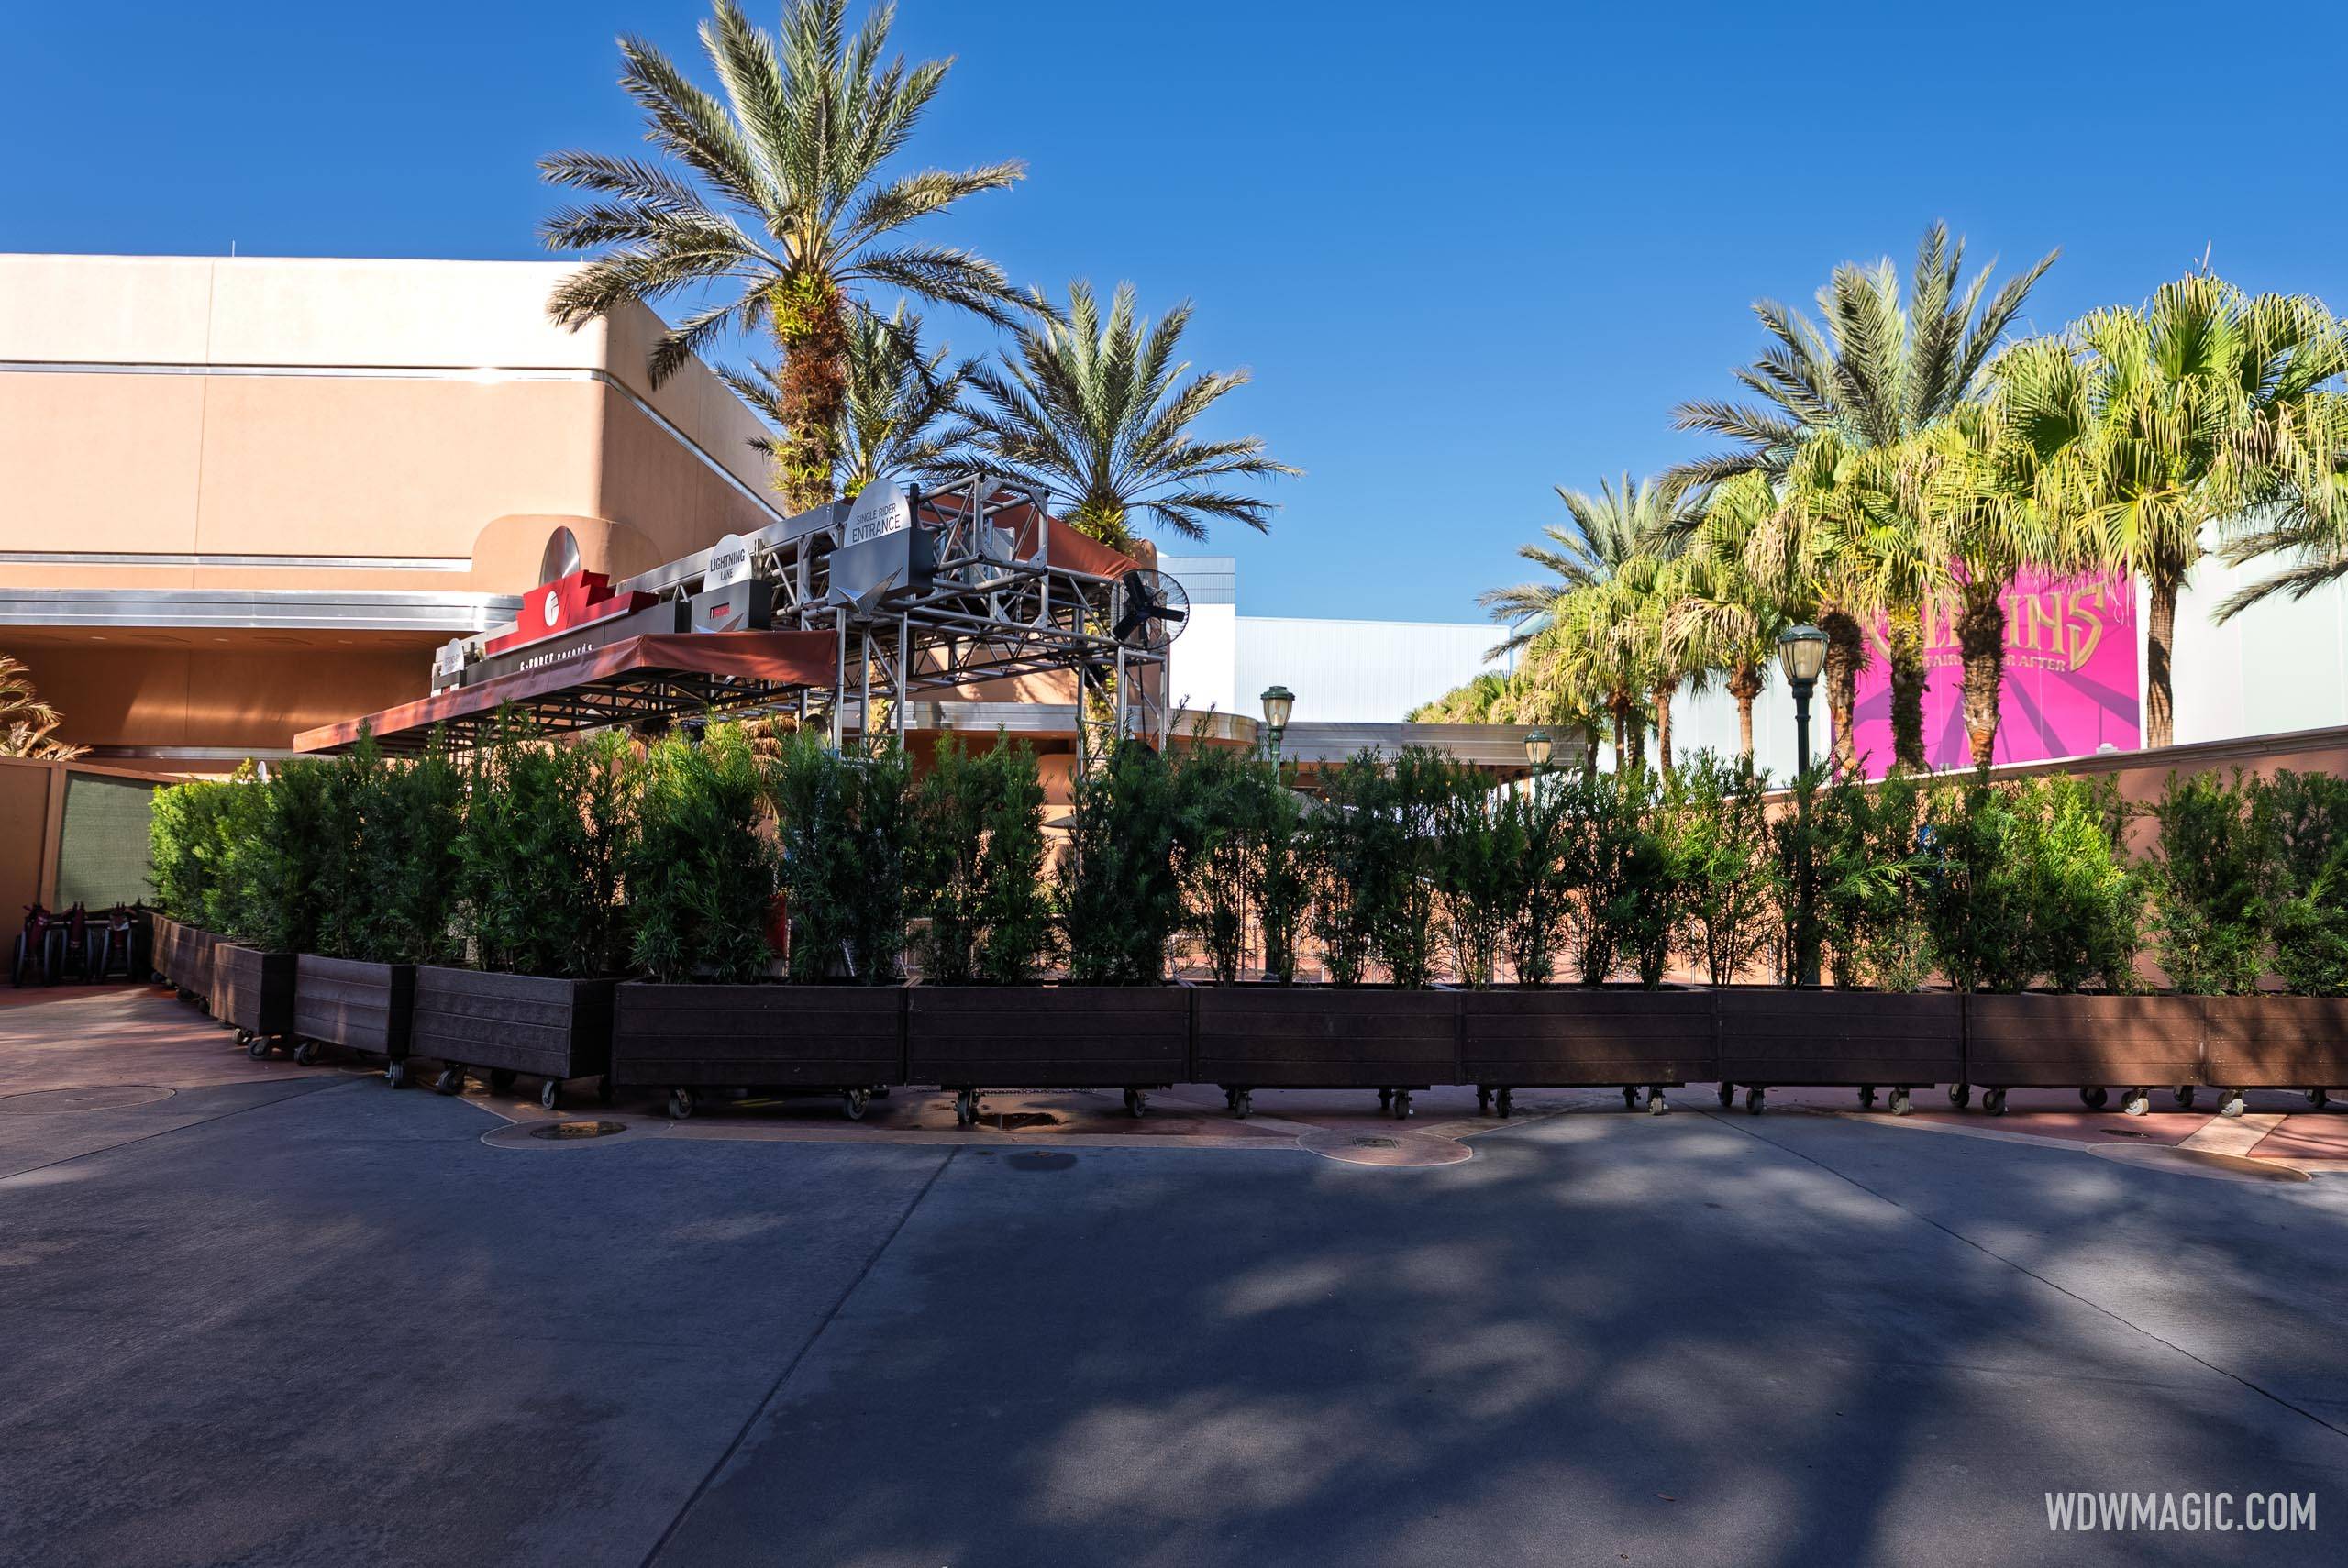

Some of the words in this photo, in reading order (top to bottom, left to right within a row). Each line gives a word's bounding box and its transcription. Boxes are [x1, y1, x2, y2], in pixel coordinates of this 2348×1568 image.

[857, 509, 878, 525] SINGLE
[879, 502, 897, 517] RIDER
[852, 513, 901, 543] ENTRANCE
[710, 548, 746, 572] LIGHTNING
[720, 568, 734, 581] LANE
[2018, 655, 2066, 672] AFTER
